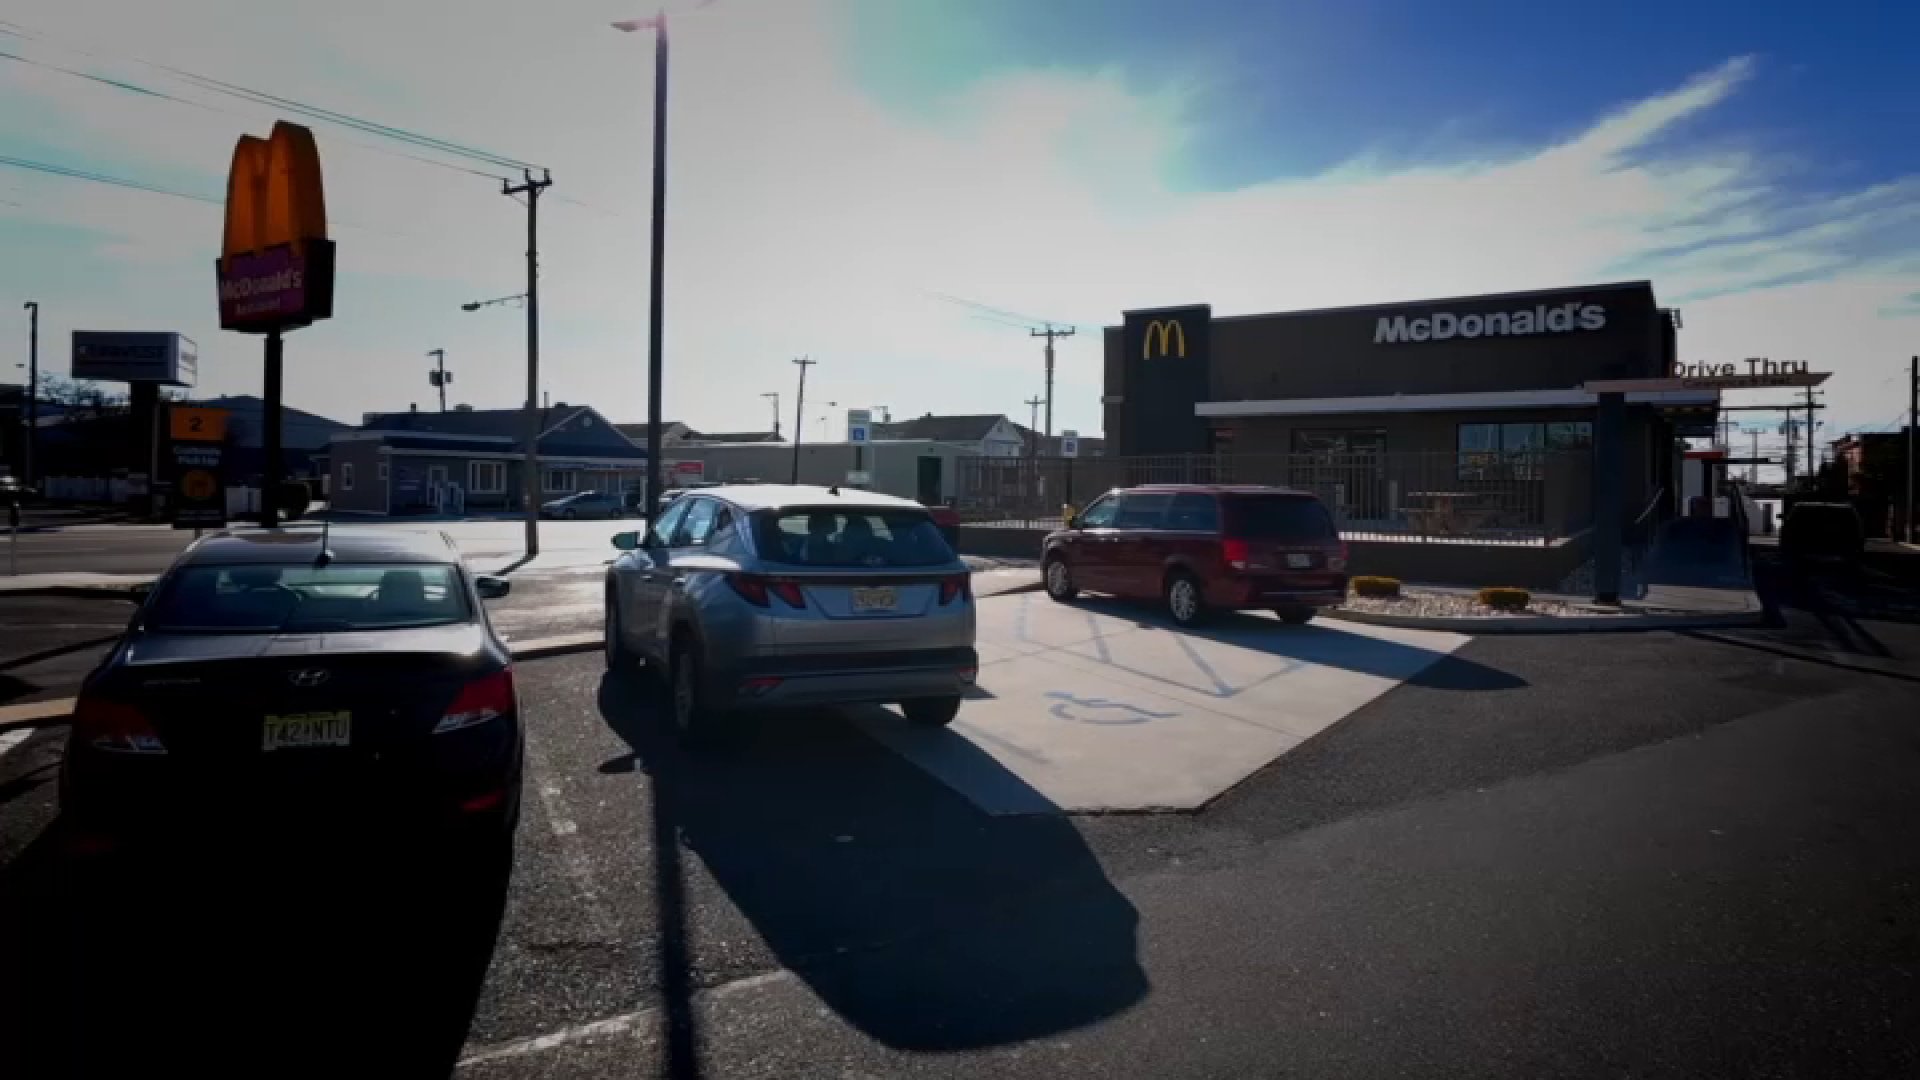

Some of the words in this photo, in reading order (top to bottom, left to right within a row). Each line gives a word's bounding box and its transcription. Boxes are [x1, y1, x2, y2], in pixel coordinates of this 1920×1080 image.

[1373, 302, 1607, 344] McDonald's
[1670, 360, 1735, 379] Drive
[1744, 357, 1809, 377] Thru
[188, 415, 203, 432] 2
